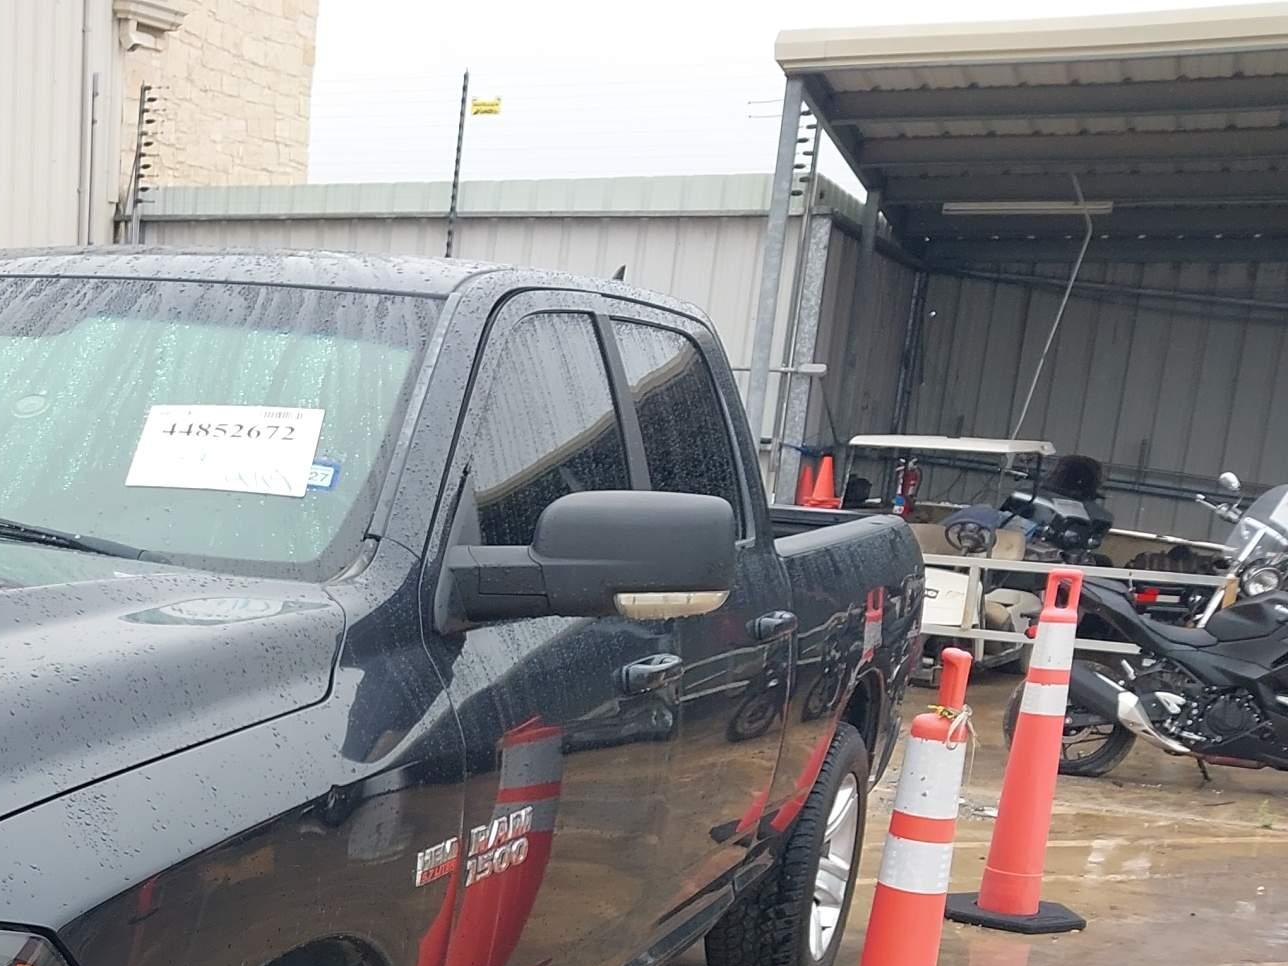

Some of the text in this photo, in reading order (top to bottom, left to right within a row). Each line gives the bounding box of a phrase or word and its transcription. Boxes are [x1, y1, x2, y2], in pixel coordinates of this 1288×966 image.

[162, 422, 296, 441] 44852672
[308, 471, 329, 482] 27
[465, 837, 529, 887] 1500
